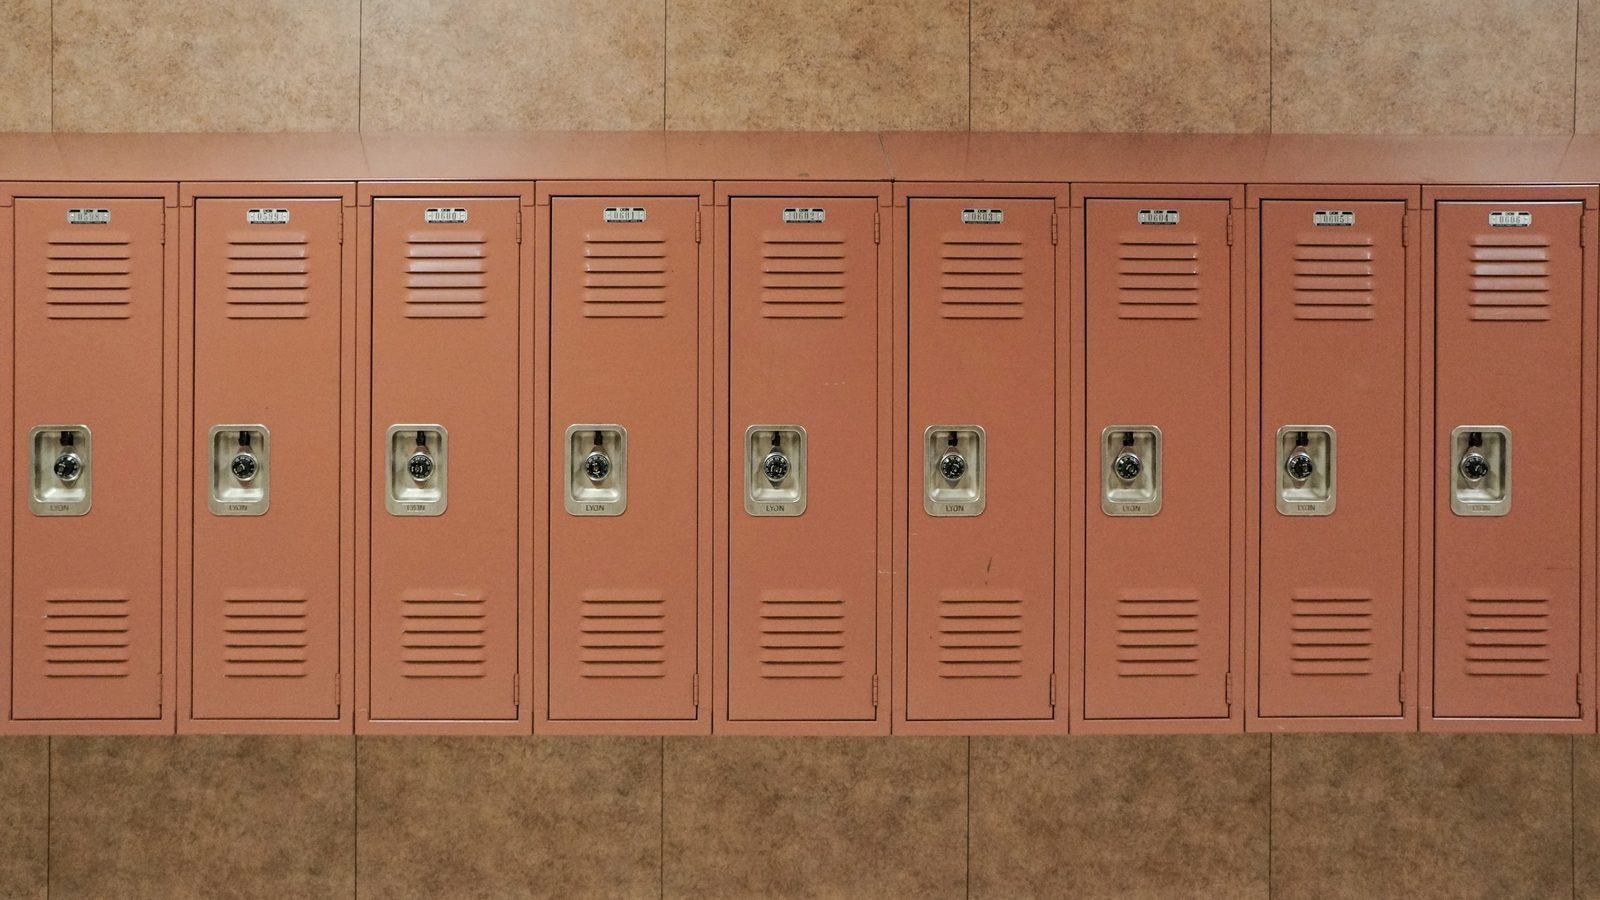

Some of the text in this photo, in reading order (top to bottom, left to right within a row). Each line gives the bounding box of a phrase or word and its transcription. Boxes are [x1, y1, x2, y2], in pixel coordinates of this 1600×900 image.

[613, 212, 635, 220] 0601
[793, 212, 815, 220] 0602
[971, 213, 993, 221] 0603
[1147, 214, 1169, 222] 0604
[1323, 215, 1345, 223] 0605
